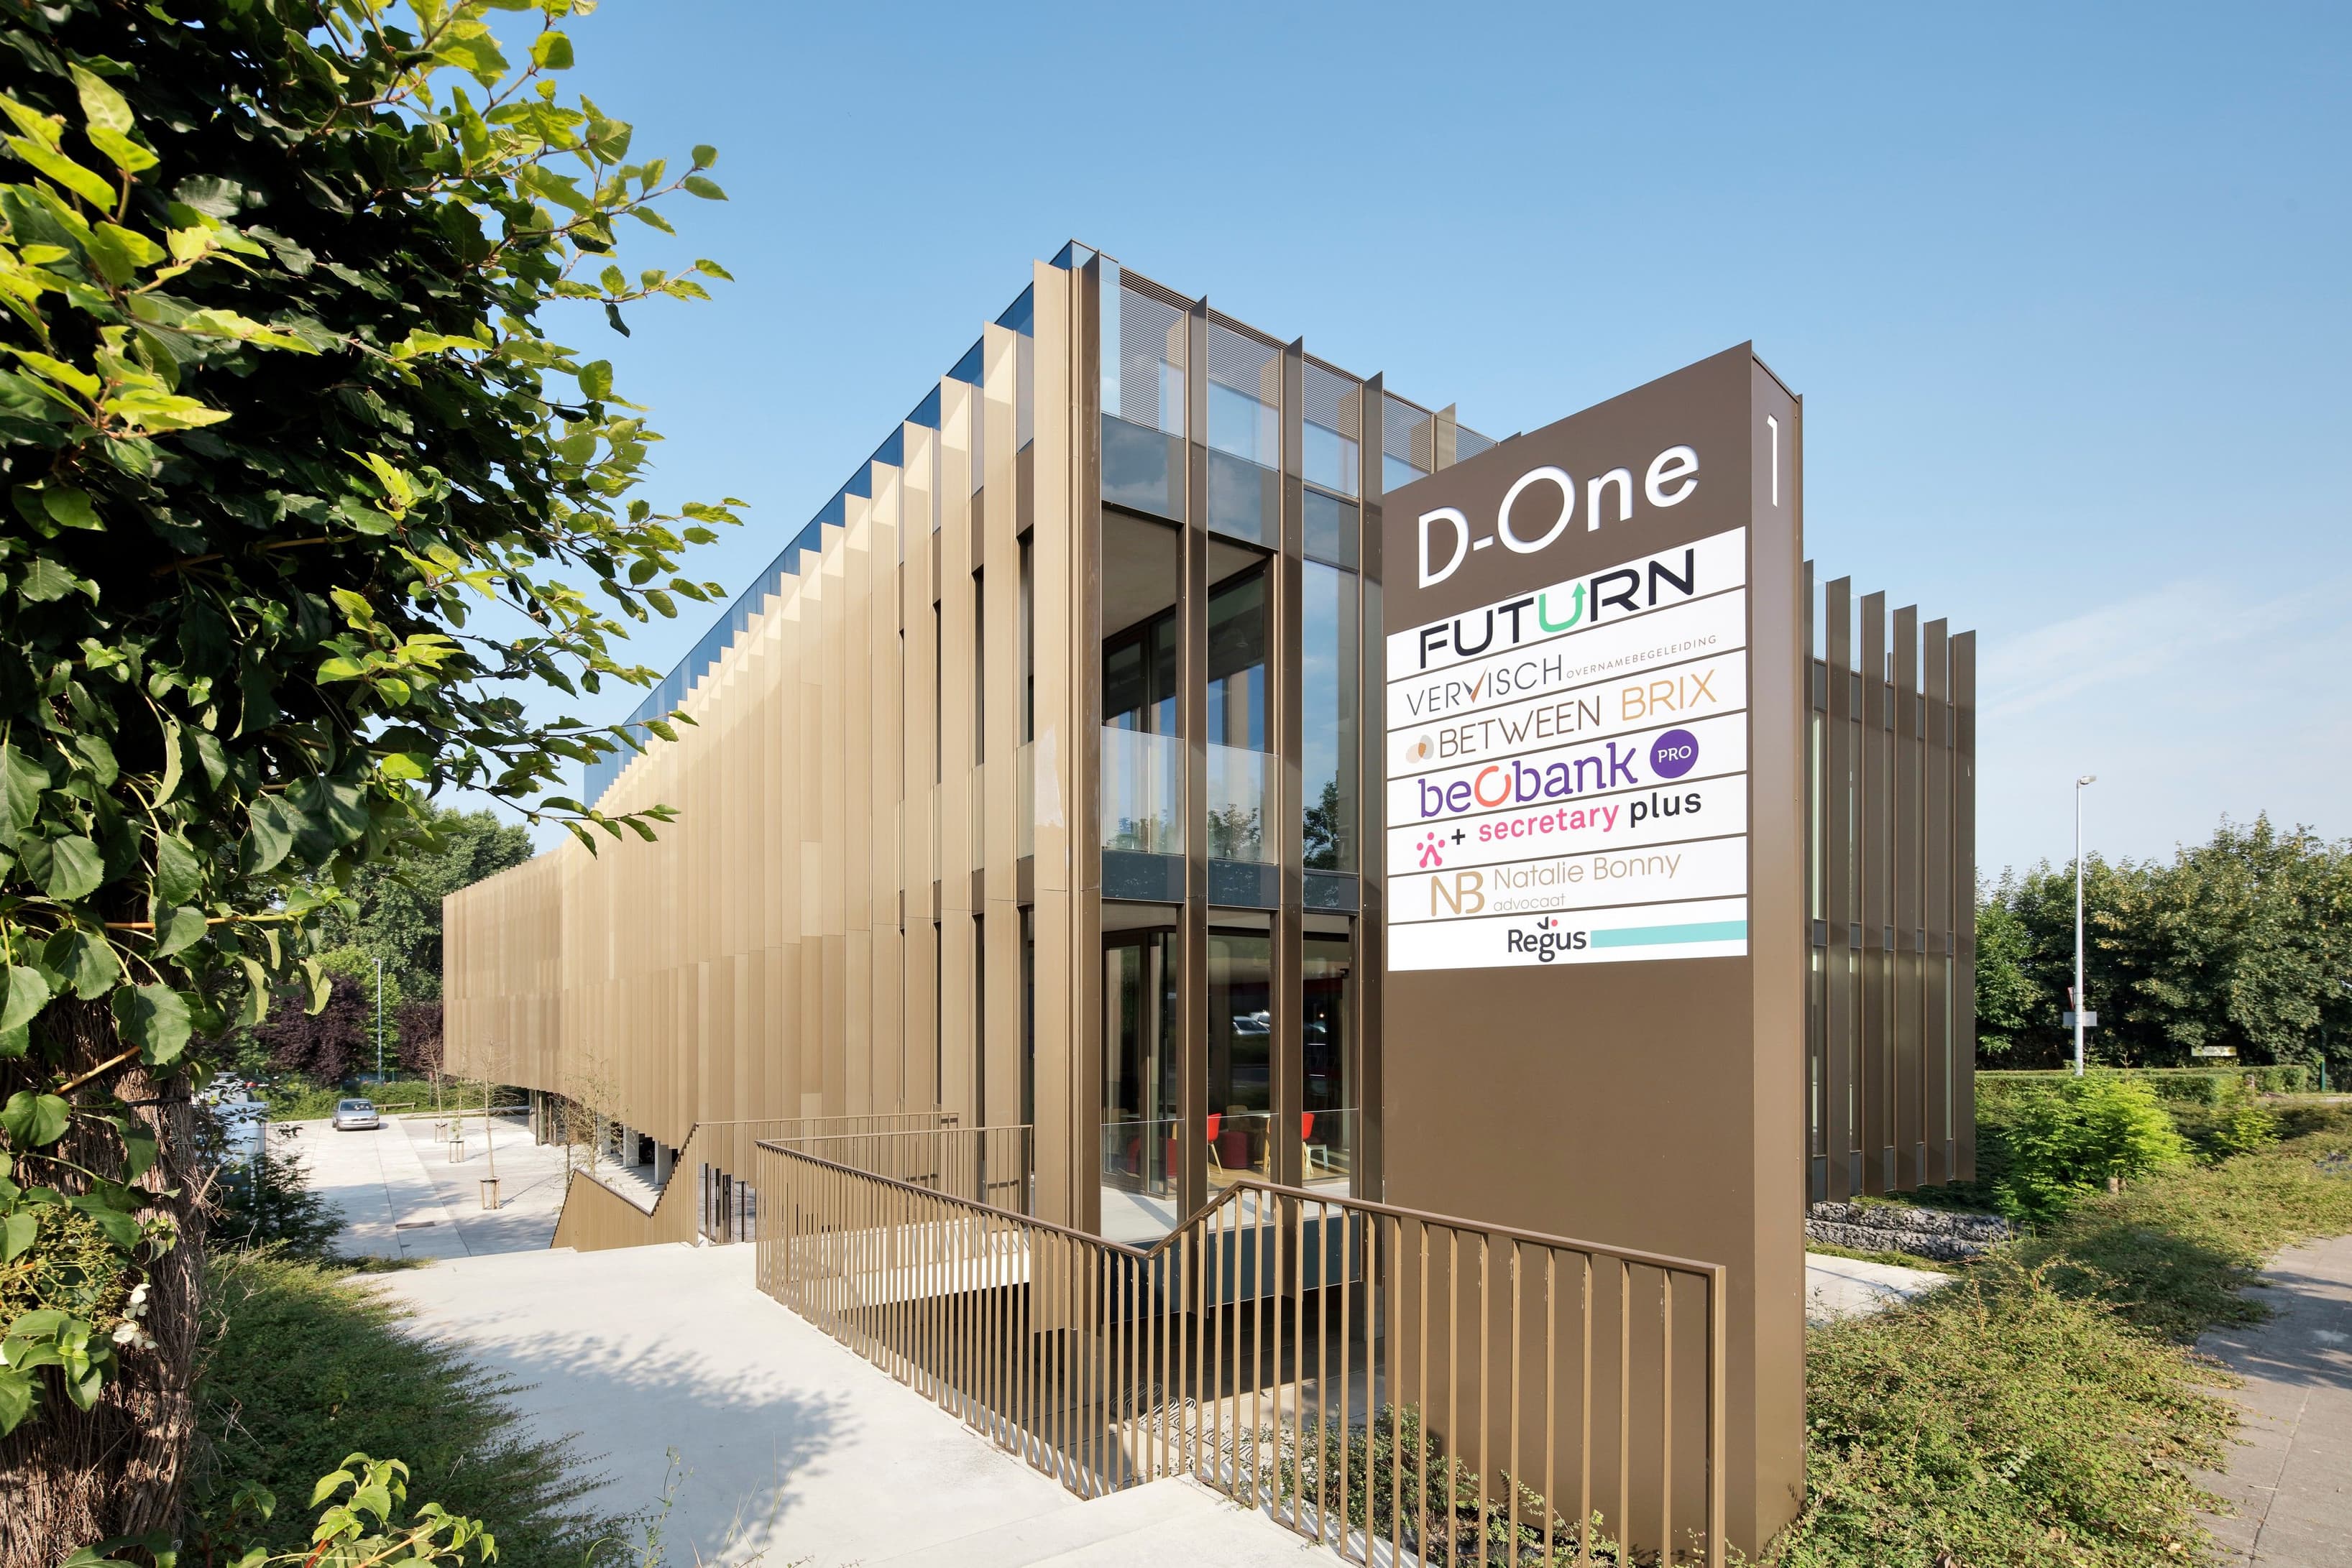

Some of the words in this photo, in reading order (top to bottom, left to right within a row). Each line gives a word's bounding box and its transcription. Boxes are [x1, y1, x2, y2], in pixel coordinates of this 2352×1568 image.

[1418, 443, 1699, 589] D-One
[1420, 548, 1694, 668] FUTURN
[1406, 654, 1562, 716] VERVISCH
[1566, 635, 1717, 679] OVERNAMEBEGELEIDING
[1439, 696, 1601, 758] BETWEEN
[1622, 669, 1717, 721] BRIX
[1658, 744, 1692, 764] PRO
[1479, 804, 1620, 842] secretary
[1630, 793, 1702, 828] plus
[1430, 870, 1485, 918] NB
[1494, 862, 1584, 891] Natalie
[1593, 854, 1681, 881] Bonny
[1493, 893, 1566, 912] advocaat
[1507, 927, 1587, 963] Regus
